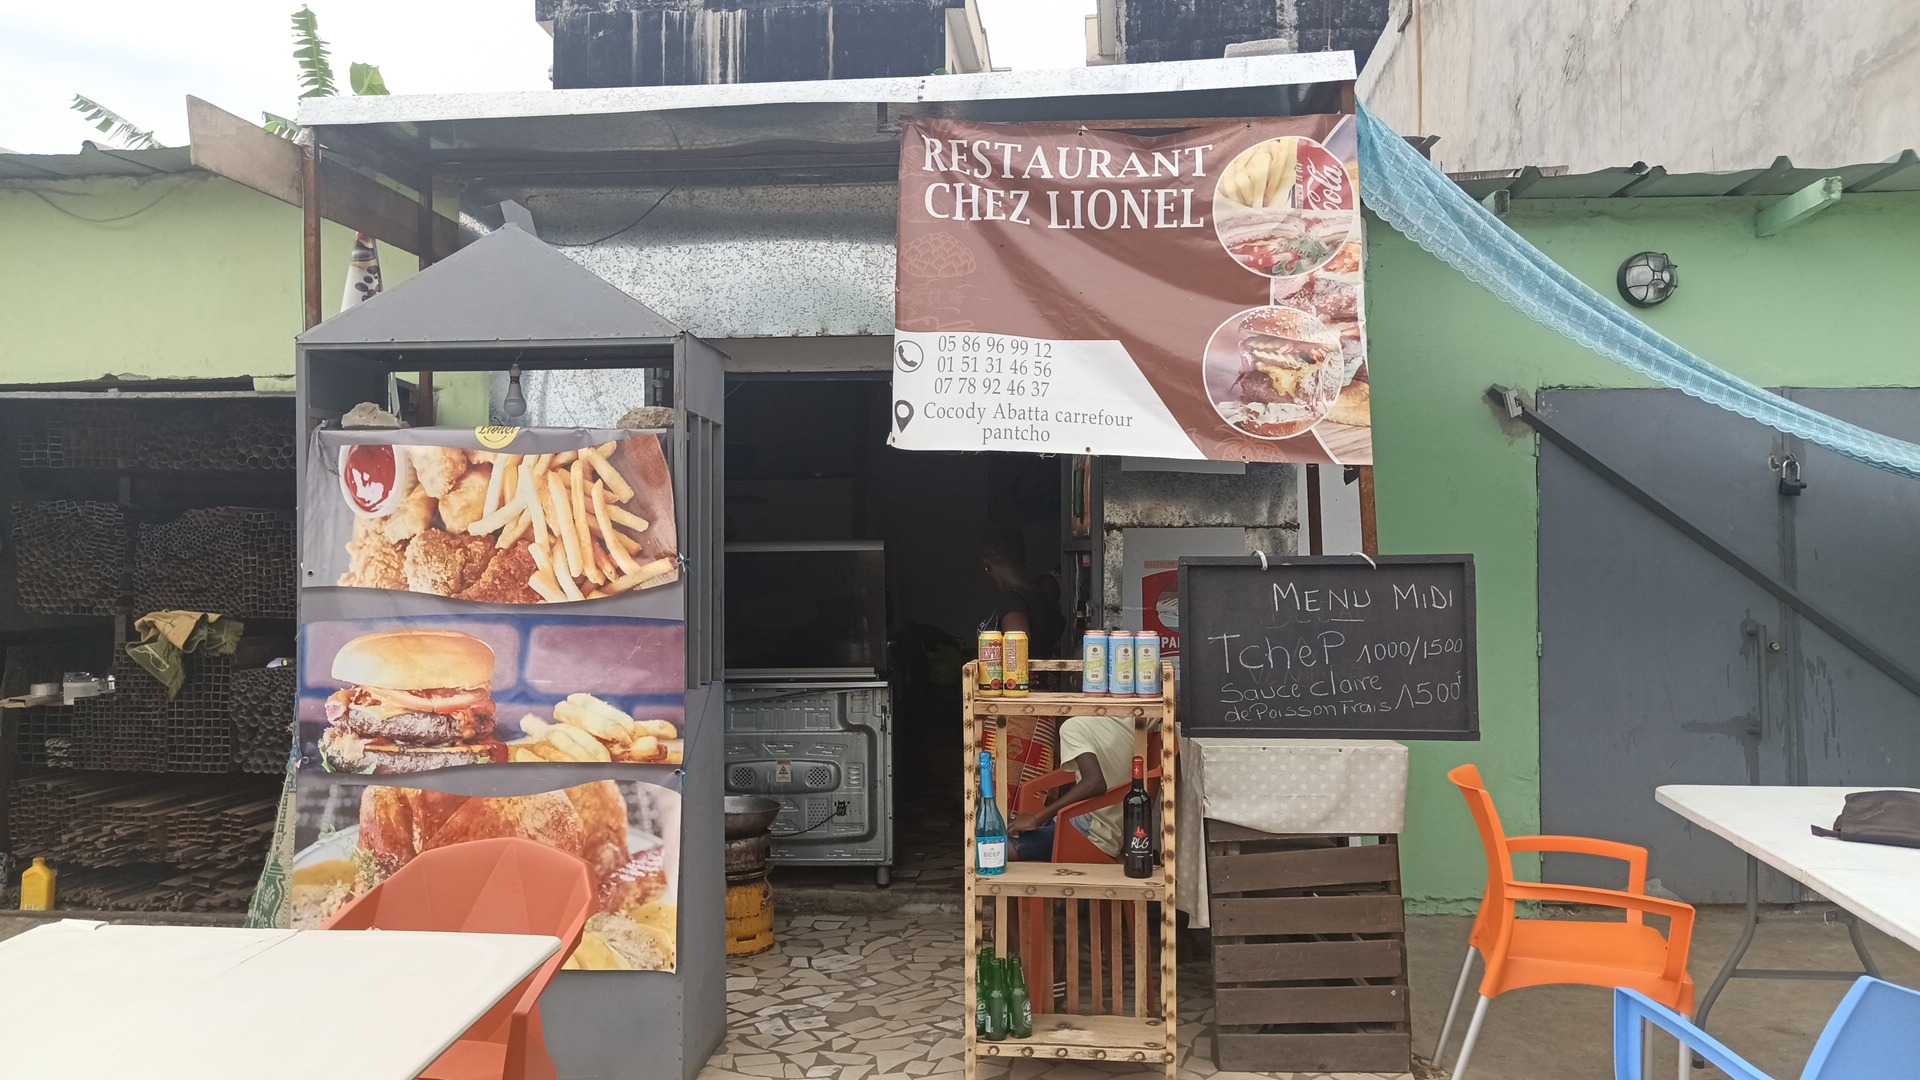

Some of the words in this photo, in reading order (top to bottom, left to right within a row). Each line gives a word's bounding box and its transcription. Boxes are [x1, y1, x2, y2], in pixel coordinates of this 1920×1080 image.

[921, 134, 1213, 179] RESTAURANT
[924, 182, 1031, 225] CHEZ
[1046, 188, 1205, 230] LIONEL
[938, 335, 956, 352] 05
[962, 335, 980, 353] 86
[986, 336, 1005, 354] 96
[1010, 338, 1029, 356] 99
[1034, 342, 1052, 358] 12
[937, 356, 954, 373] 01
[960, 356, 978, 373] 51
[985, 356, 1003, 373] 31
[1009, 358, 1028, 376] 46
[1033, 361, 1052, 378] 56
[934, 377, 953, 395] 07
[958, 377, 977, 395] 78
[982, 377, 1001, 395] 92
[1006, 379, 1025, 397] 46
[1031, 381, 1050, 398] 37
[923, 401, 987, 425] Cocody
[993, 402, 1049, 422] Abatta
[1055, 408, 1133, 427] carrefour
[982, 424, 1050, 445] pantcho
[1272, 582, 1372, 612] MENU
[1356, 636, 1463, 666] 1000/1500
[1220, 682, 1301, 703] Sauce
[1131, 836, 1150, 849] RLG
